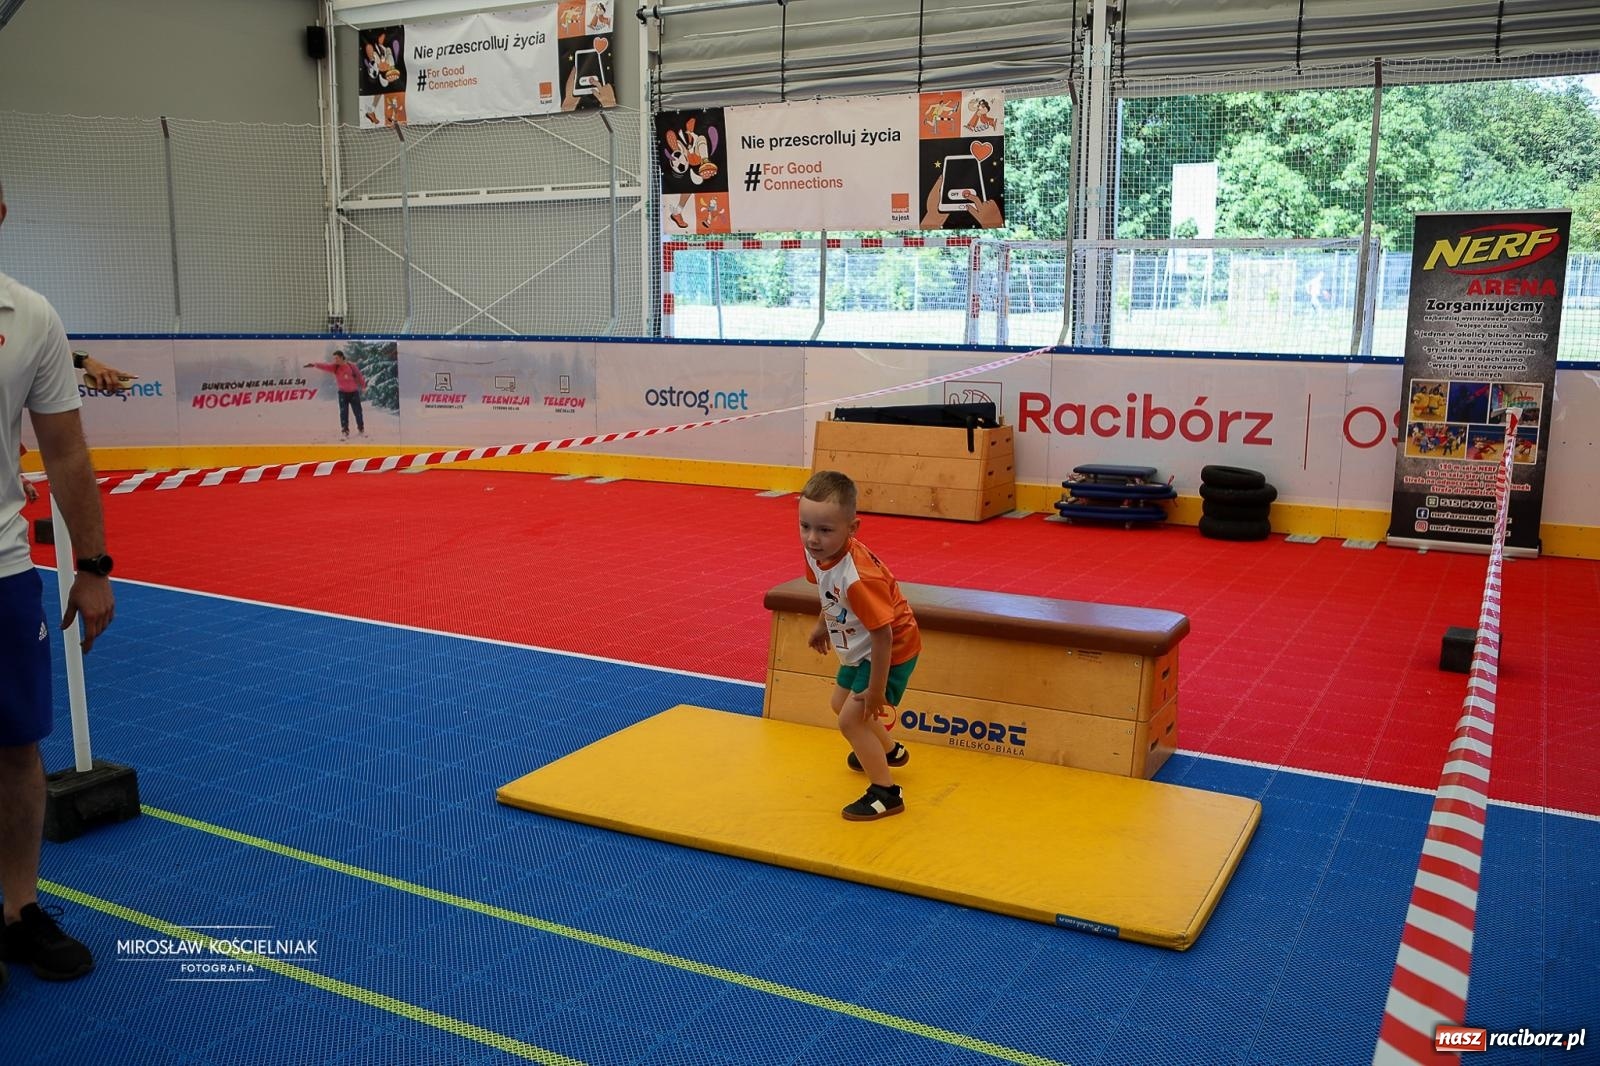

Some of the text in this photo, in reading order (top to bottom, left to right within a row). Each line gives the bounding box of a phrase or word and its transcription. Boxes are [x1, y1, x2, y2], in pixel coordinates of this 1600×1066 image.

[413, 31, 546, 59] Nie przescrolluj życia
[443, 65, 465, 77] Good
[428, 76, 477, 91] Connections
[741, 127, 901, 150] Nie przescrolluj życia
[787, 161, 822, 175] Good
[763, 177, 844, 191] Connections
[1423, 228, 1558, 271] NERF
[1467, 279, 1557, 296] ARENA
[1426, 299, 1544, 314] Zorganizujemy
[246, 380, 260, 389] NIE
[278, 378, 294, 386] ALE
[192, 388, 319, 409] MOCNE PAKIETY
[420, 394, 467, 403] INTERNET
[481, 395, 530, 406] TELEWIZJA
[543, 396, 586, 408] TELEFON
[645, 385, 748, 415] ostrog.net
[1018, 391, 1274, 446] Racibórz
[1343, 406, 1400, 449] O
[901, 710, 1027, 746] OLSPORT
[949, 738, 1025, 756] BIELSKO-BIAŁA
